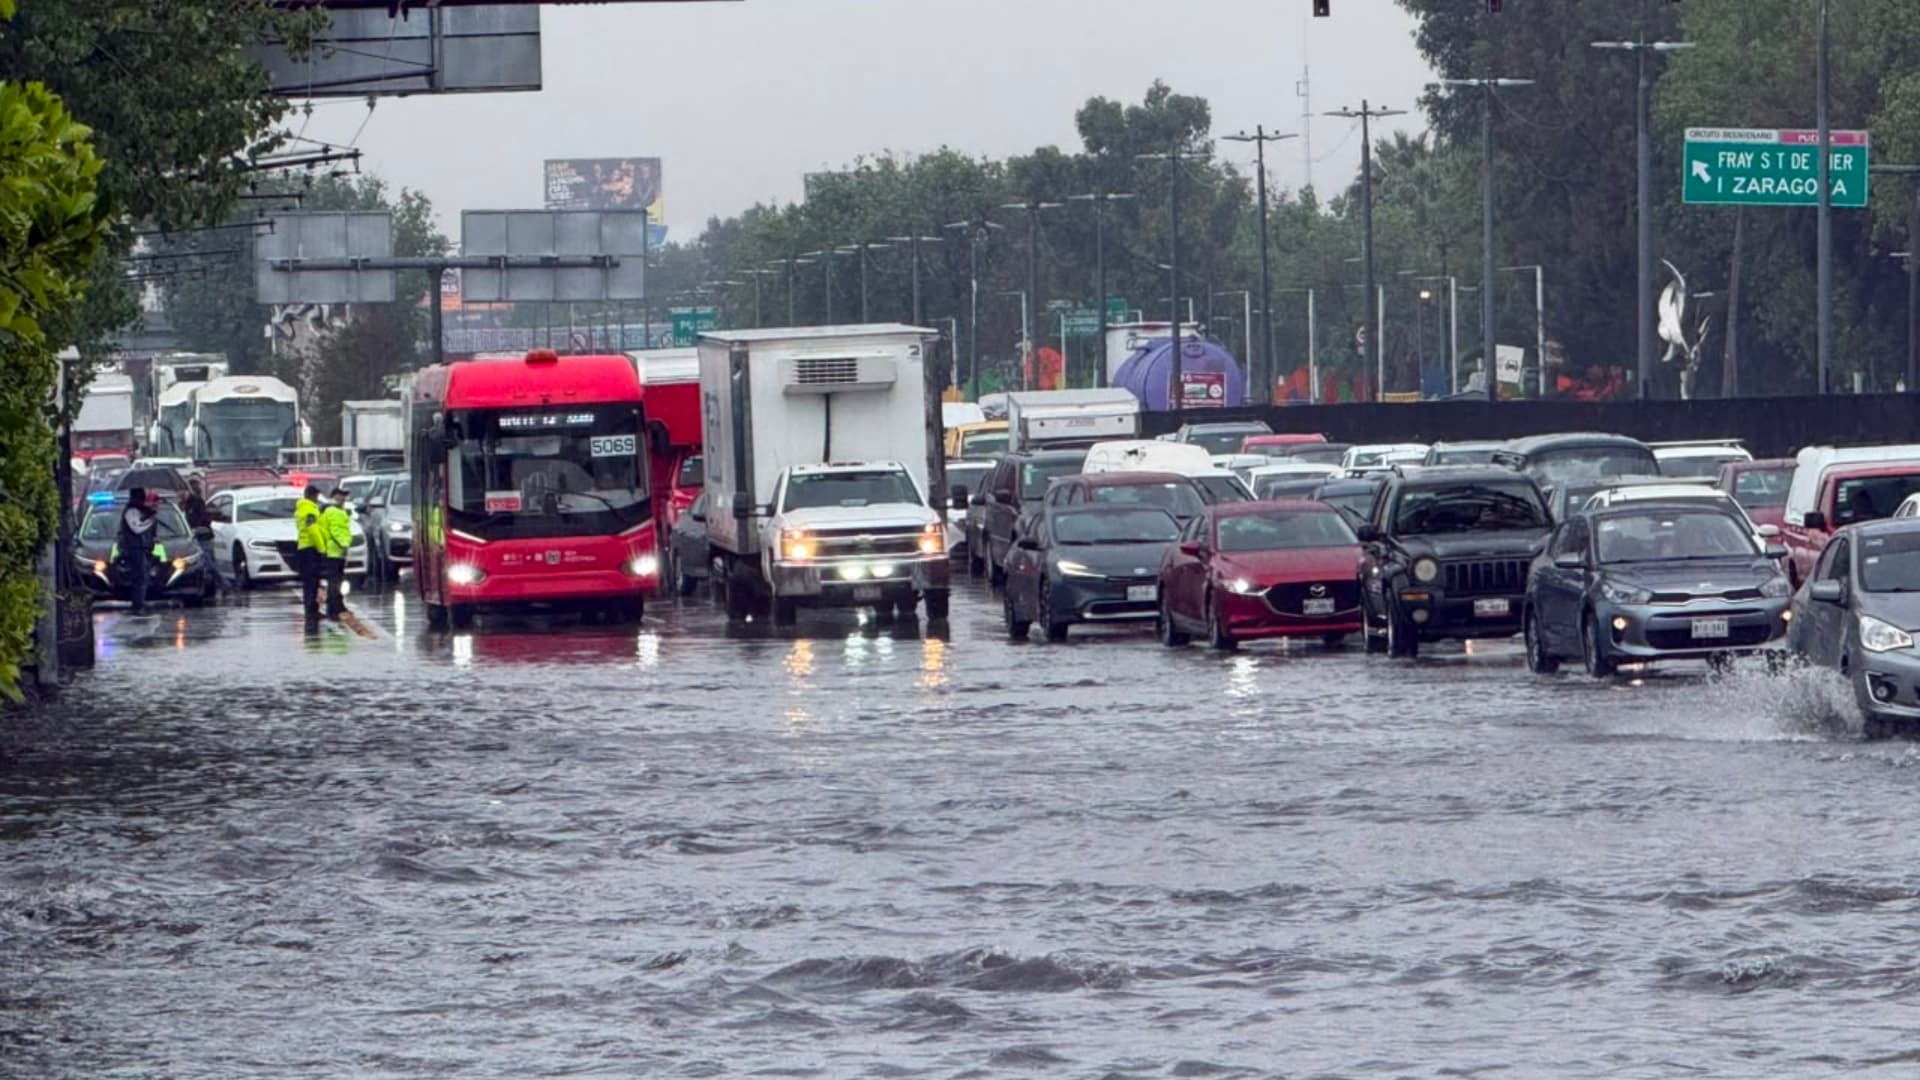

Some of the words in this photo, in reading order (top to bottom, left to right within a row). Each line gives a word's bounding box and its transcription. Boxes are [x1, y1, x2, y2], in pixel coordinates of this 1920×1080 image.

[1689, 130, 1720, 138] CIRCUITO
[1722, 131, 1773, 139] BICENTENARIO
[1718, 152, 1754, 168] FRAY
[1760, 152, 1770, 169] S
[1776, 153, 1785, 170] T
[1791, 153, 1810, 170] DE
[1733, 177, 1847, 196] ZARAGOA
[909, 345, 920, 355] 2
[592, 438, 634, 454] 5069
